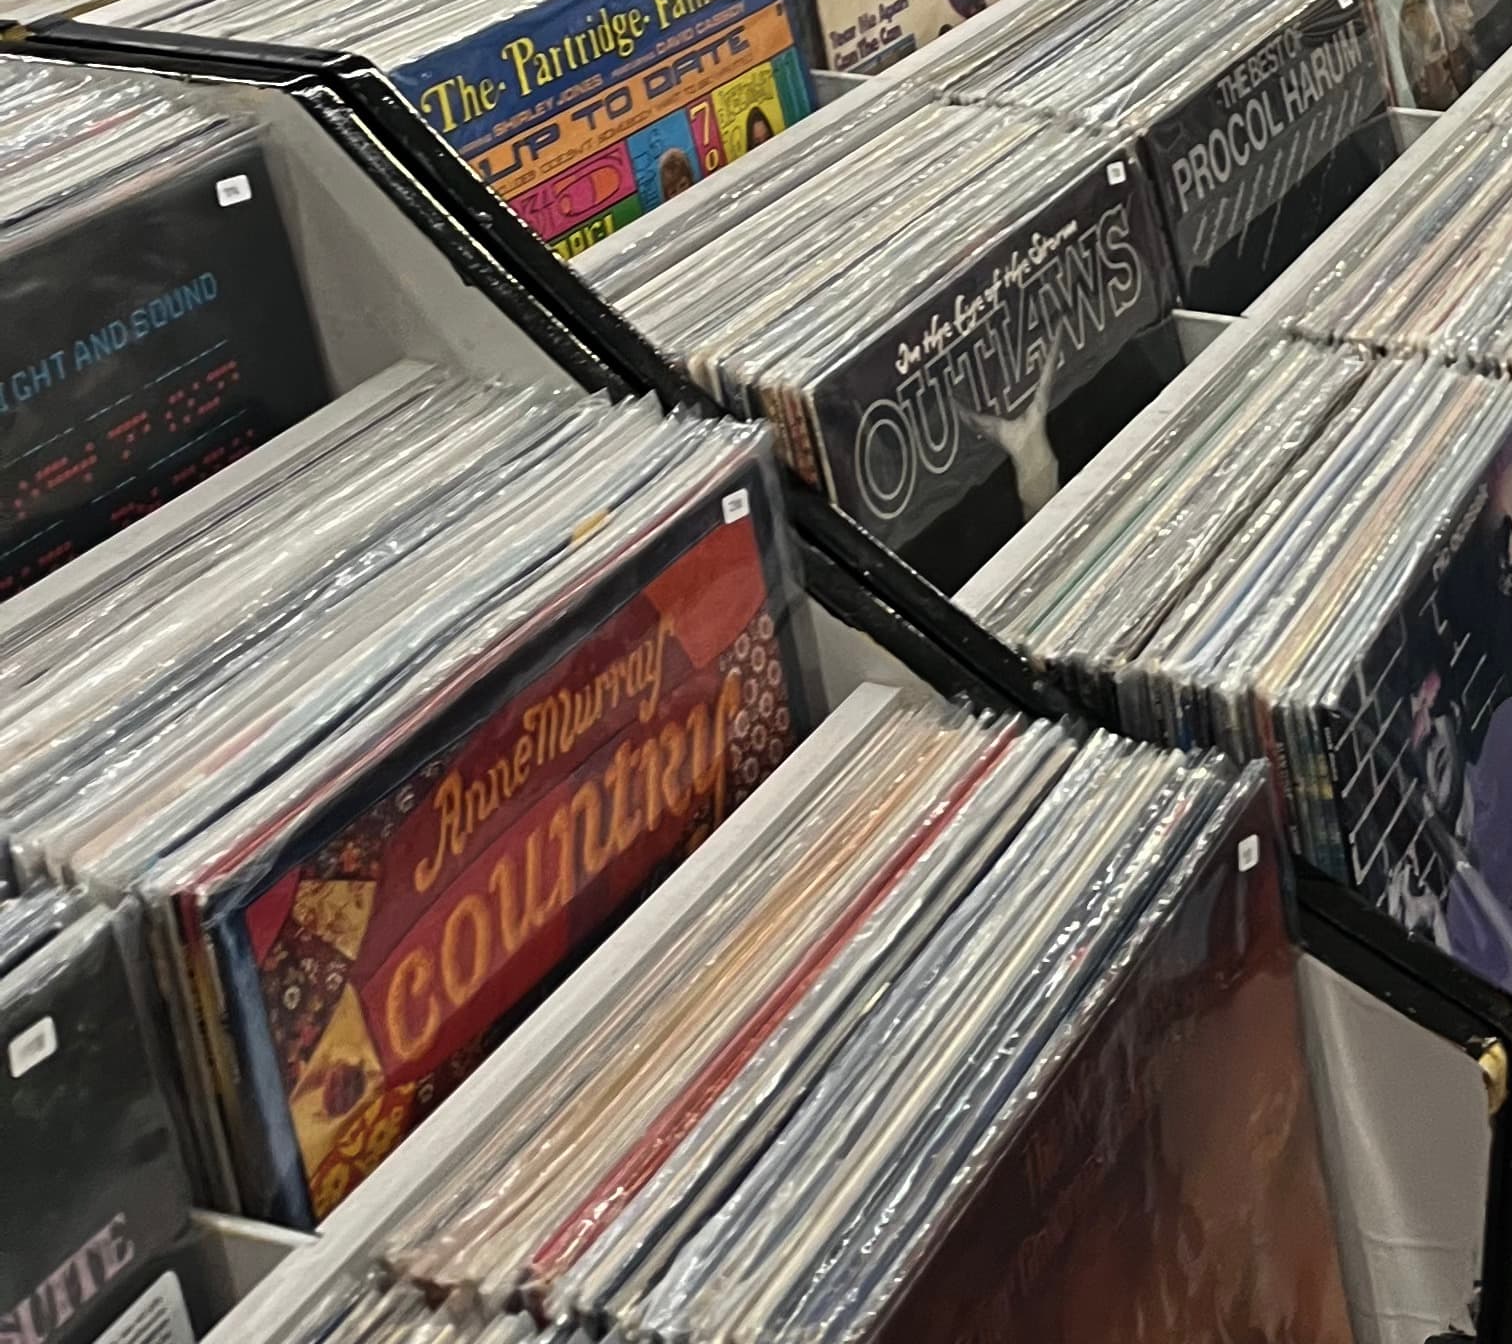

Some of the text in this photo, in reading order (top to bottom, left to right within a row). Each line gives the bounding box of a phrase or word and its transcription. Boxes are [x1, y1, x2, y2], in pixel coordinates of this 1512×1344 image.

[421, 73, 495, 134] The
[502, 7, 644, 98] Partridge
[477, 122, 562, 185] UP
[573, 89, 633, 140] TO
[643, 24, 752, 101] DATE
[556, 74, 604, 105] JONES
[1172, 18, 1363, 214] PROCOL HARUM
[1217, 71, 1251, 109] THE
[1250, 34, 1287, 87] BEST
[0, 271, 220, 412] IGHT AND SOUND
[854, 194, 1143, 520] OUTLAWS
[414, 618, 676, 894] Anne Murray
